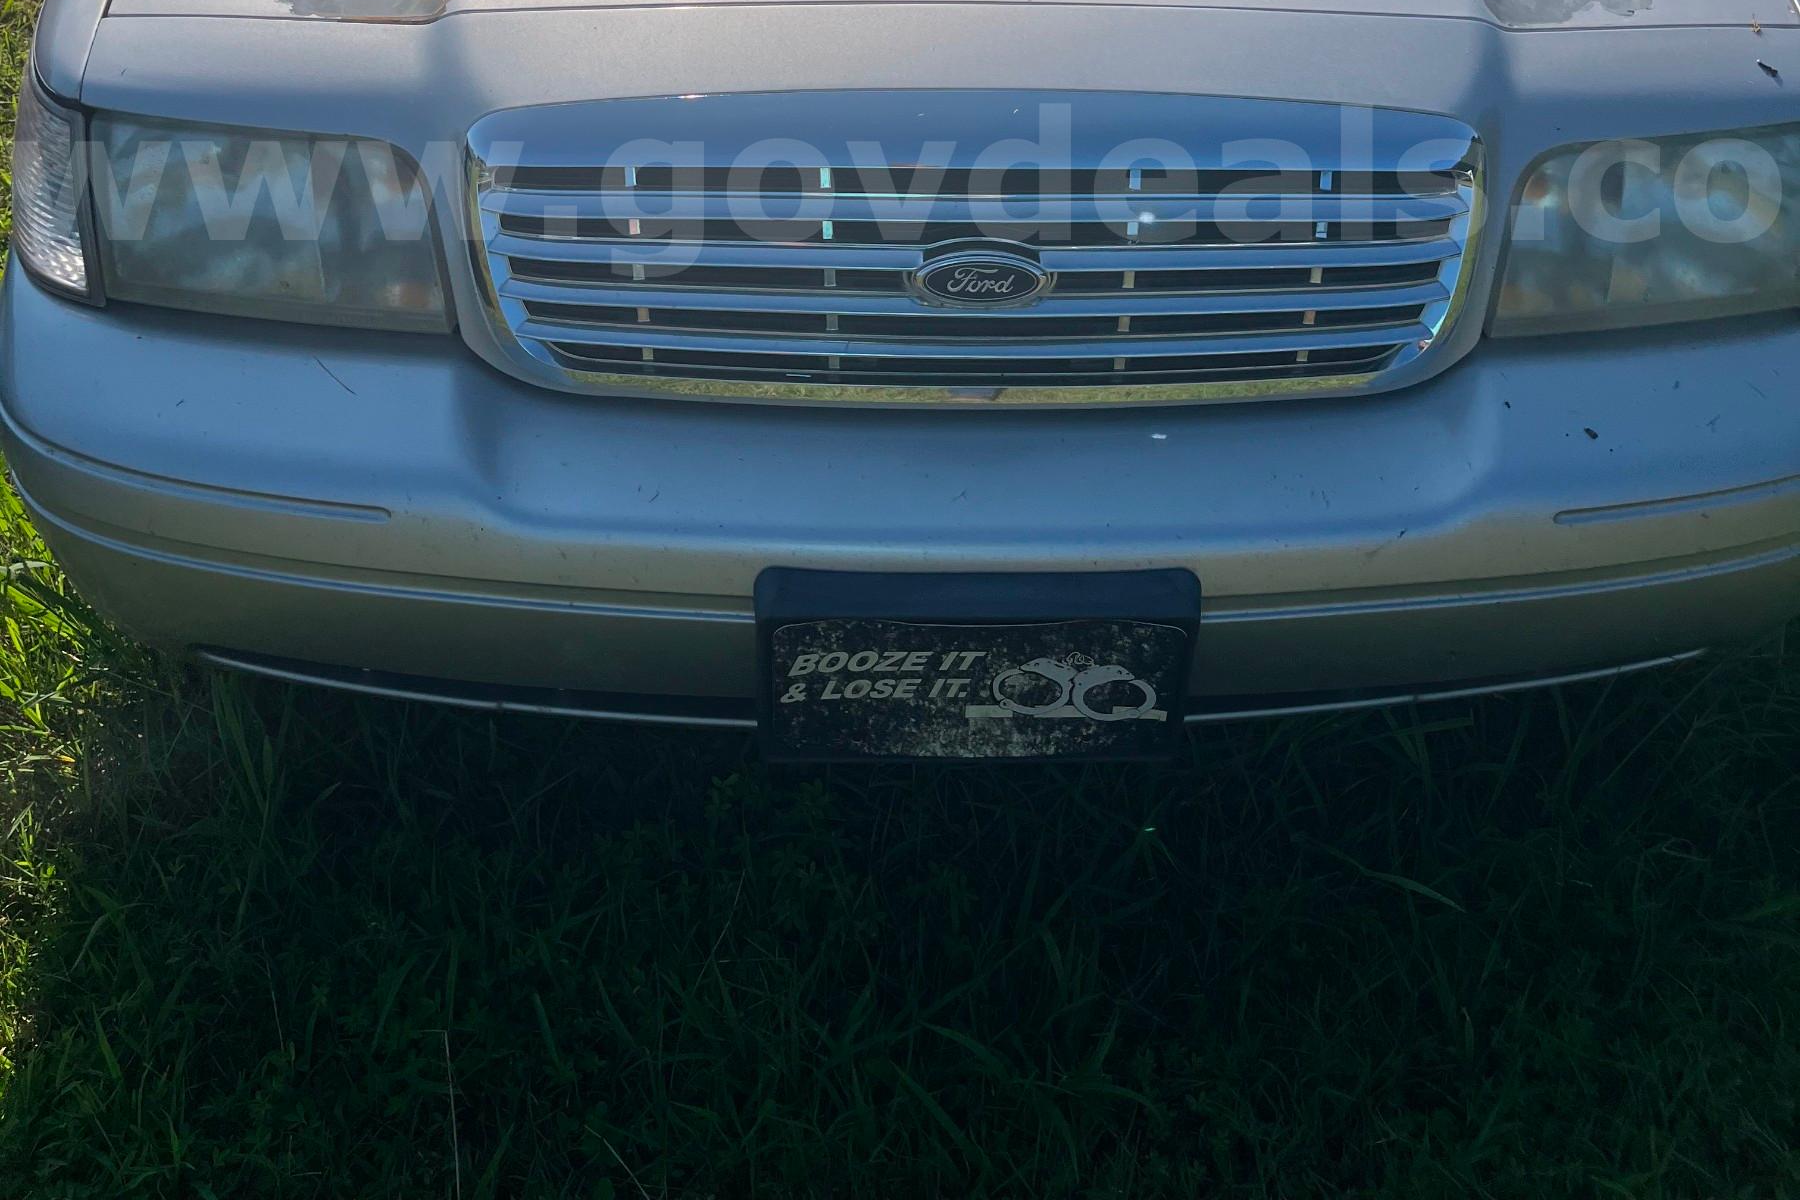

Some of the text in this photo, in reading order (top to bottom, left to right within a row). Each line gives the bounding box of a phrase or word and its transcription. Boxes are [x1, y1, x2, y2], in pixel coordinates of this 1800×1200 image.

[947, 267, 1015, 293] Ford
[787, 651, 987, 677] BOOZE IT
[780, 679, 971, 704] & LOSE IT.
